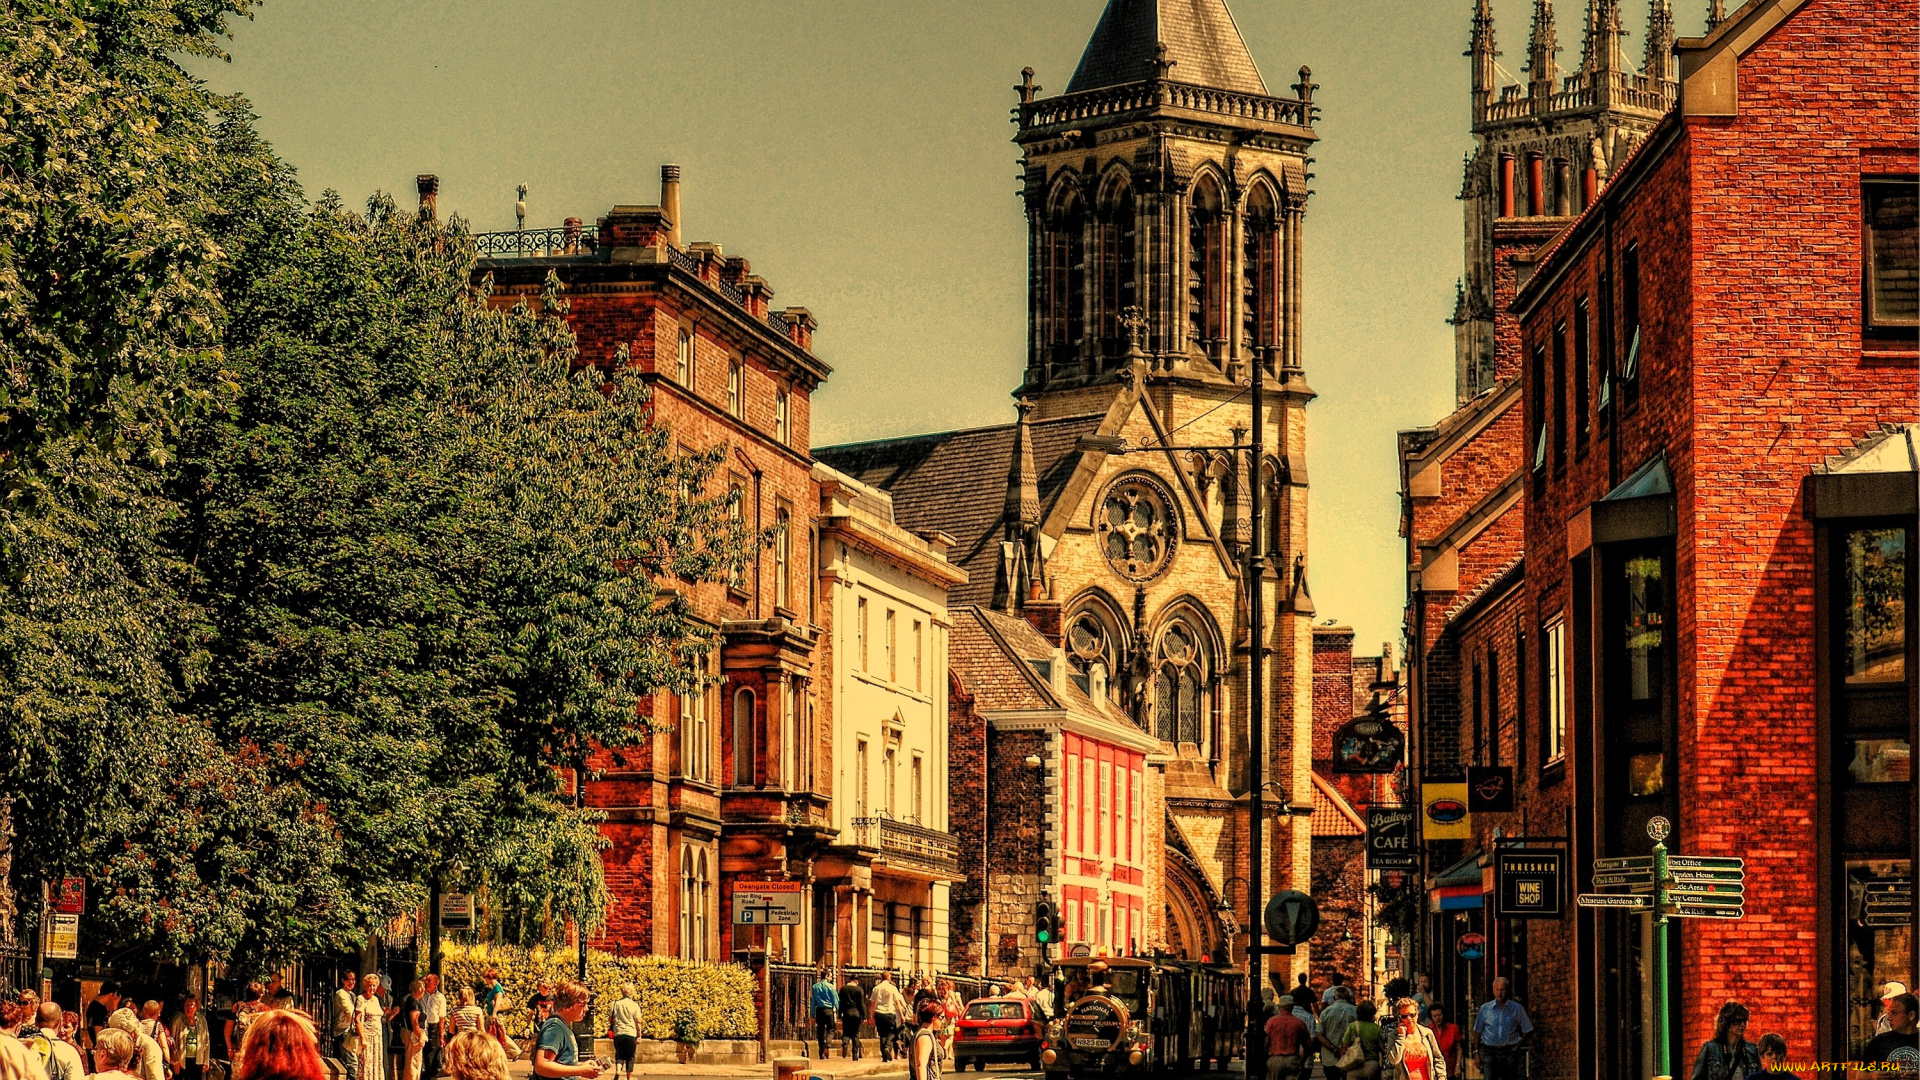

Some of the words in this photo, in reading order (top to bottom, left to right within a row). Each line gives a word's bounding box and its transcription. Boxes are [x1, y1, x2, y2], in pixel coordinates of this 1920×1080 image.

[1370, 811, 1413, 828] Baileys
[1373, 833, 1409, 849] CAFÉ
[1503, 863, 1555, 872] THRESHER
[1681, 859, 1702, 867] Office
[1695, 871, 1715, 879] House
[1519, 882, 1541, 893] WINE
[1519, 893, 1541, 904] SHOP
[1607, 897, 1633, 905] Gardens
[1682, 894, 1703, 902] Centre
[1080, 1005, 1110, 1016] NATIONAL
